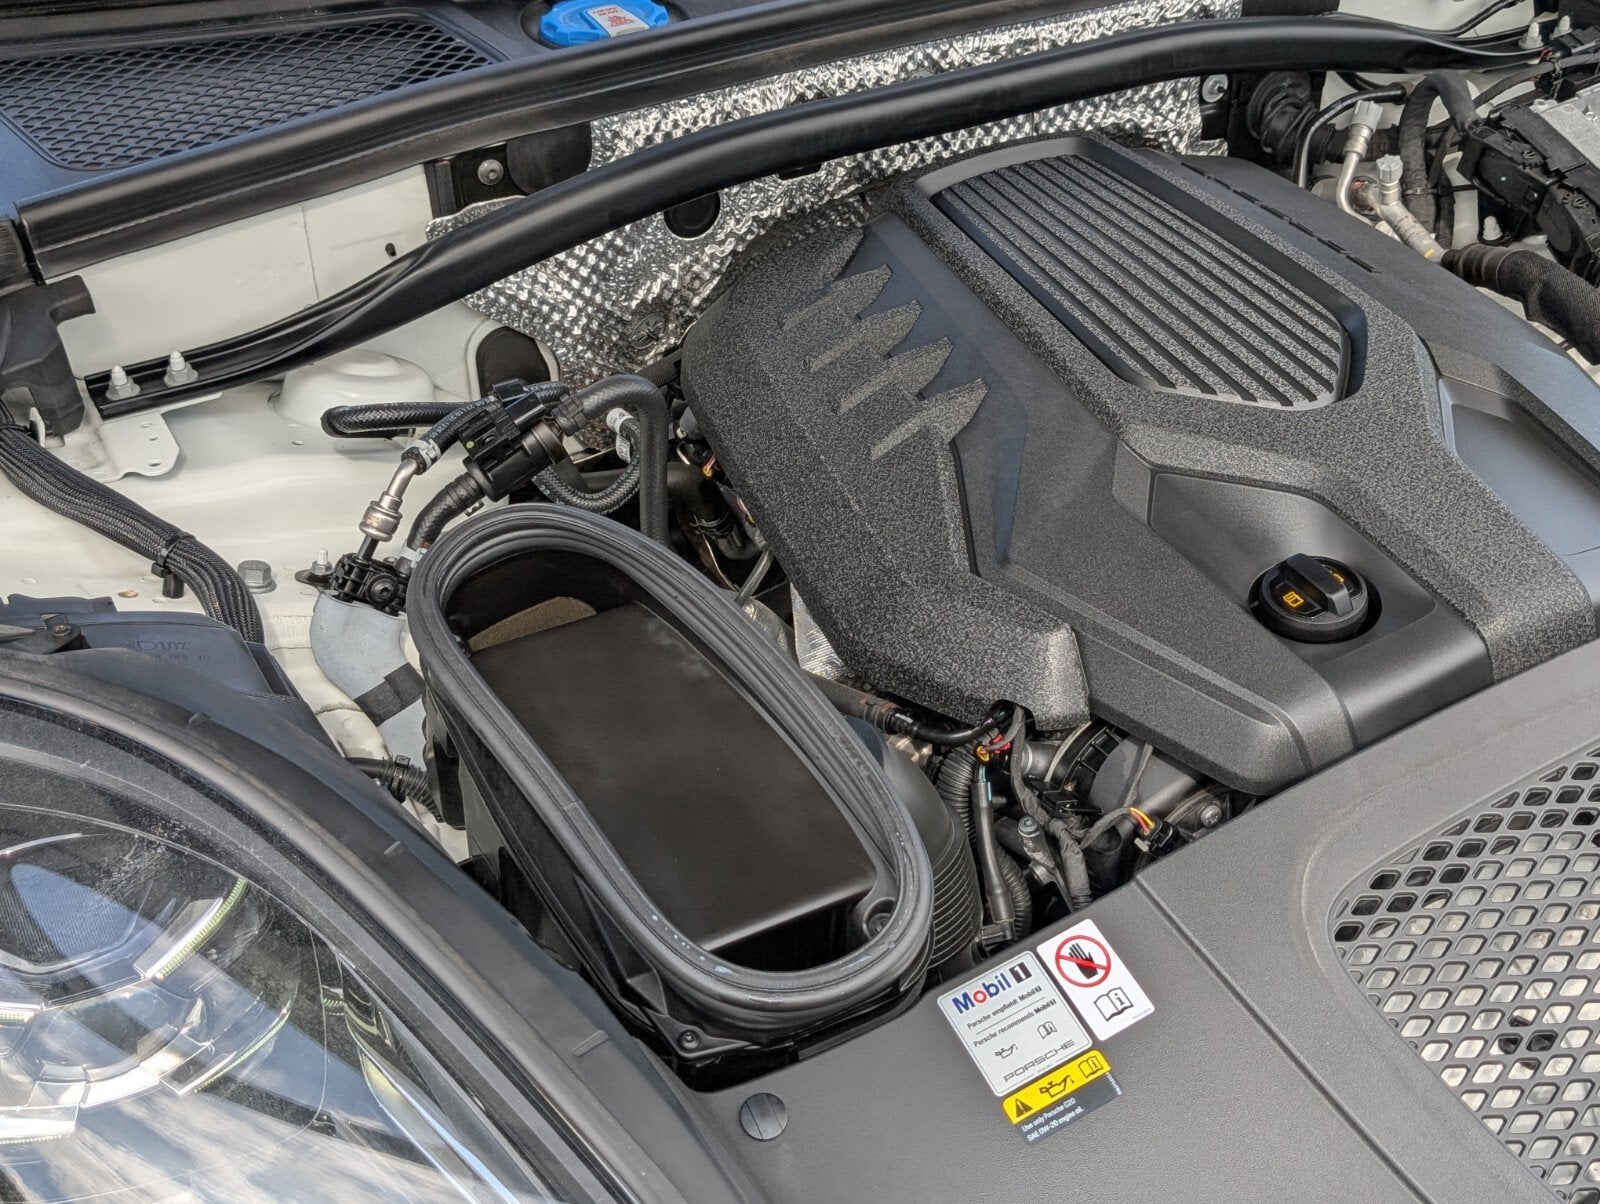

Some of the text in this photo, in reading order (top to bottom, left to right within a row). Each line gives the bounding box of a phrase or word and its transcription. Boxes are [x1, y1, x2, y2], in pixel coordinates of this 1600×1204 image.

[951, 972, 1012, 1014] Mobil
[967, 1014, 991, 1029] Porsche
[992, 999, 1018, 1016] empfiehlt
[1018, 988, 1036, 1002] Mobil
[973, 1032, 998, 1047] Porsche
[998, 1011, 1035, 1035] recommends
[1034, 1002, 1051, 1014] Mobil
[1003, 1039, 1076, 1082] PORSCHE
[1021, 1123, 1034, 1132] Use
[1033, 1116, 1045, 1128] only
[1043, 1104, 1065, 1120] Porsche
[1026, 1131, 1040, 1142] SAE
[1039, 1120, 1059, 1134] 0W-20
[1058, 1111, 1076, 1124] engine
